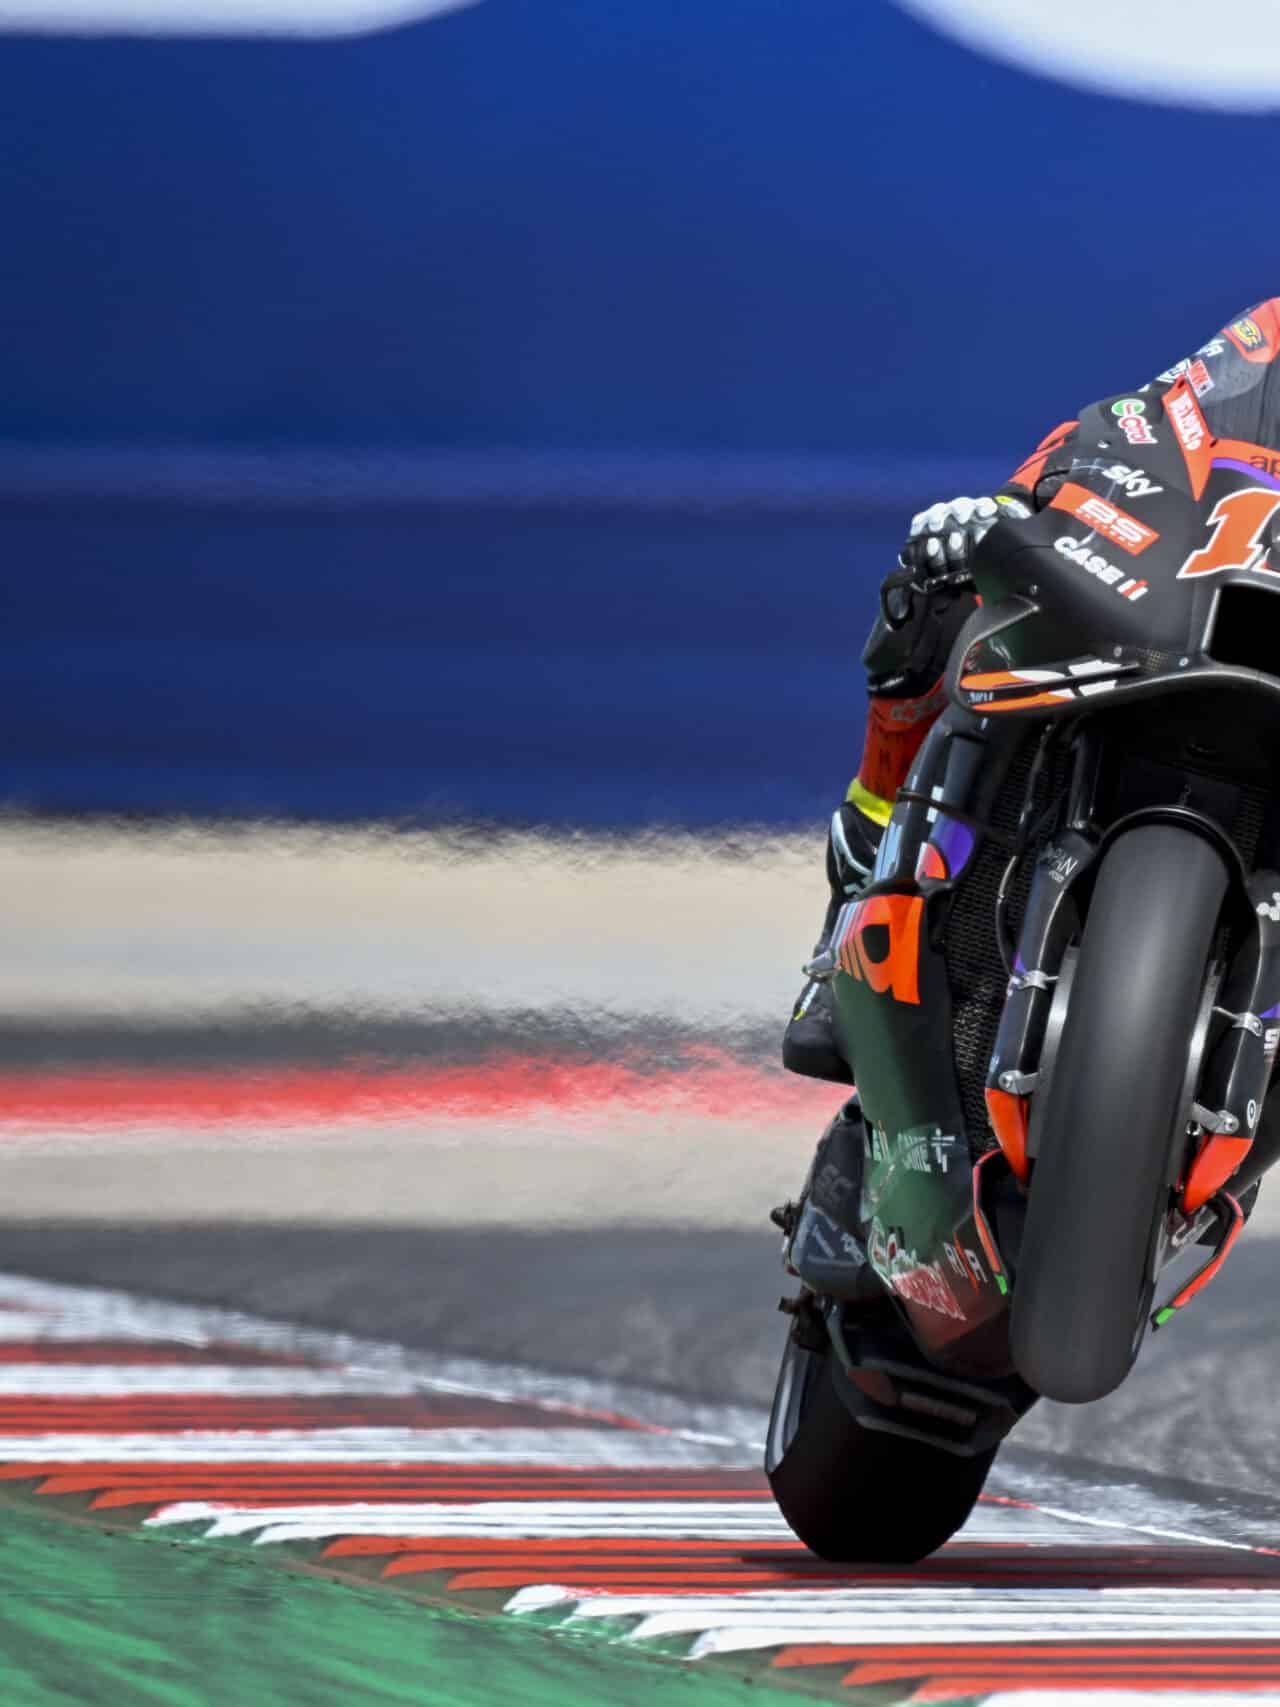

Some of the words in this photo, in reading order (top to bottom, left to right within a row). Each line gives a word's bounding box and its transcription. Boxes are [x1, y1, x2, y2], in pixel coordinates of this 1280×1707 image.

[1102, 465, 1163, 497] sky
[1076, 498, 1151, 543] BS
[1054, 536, 1125, 584] CASE
